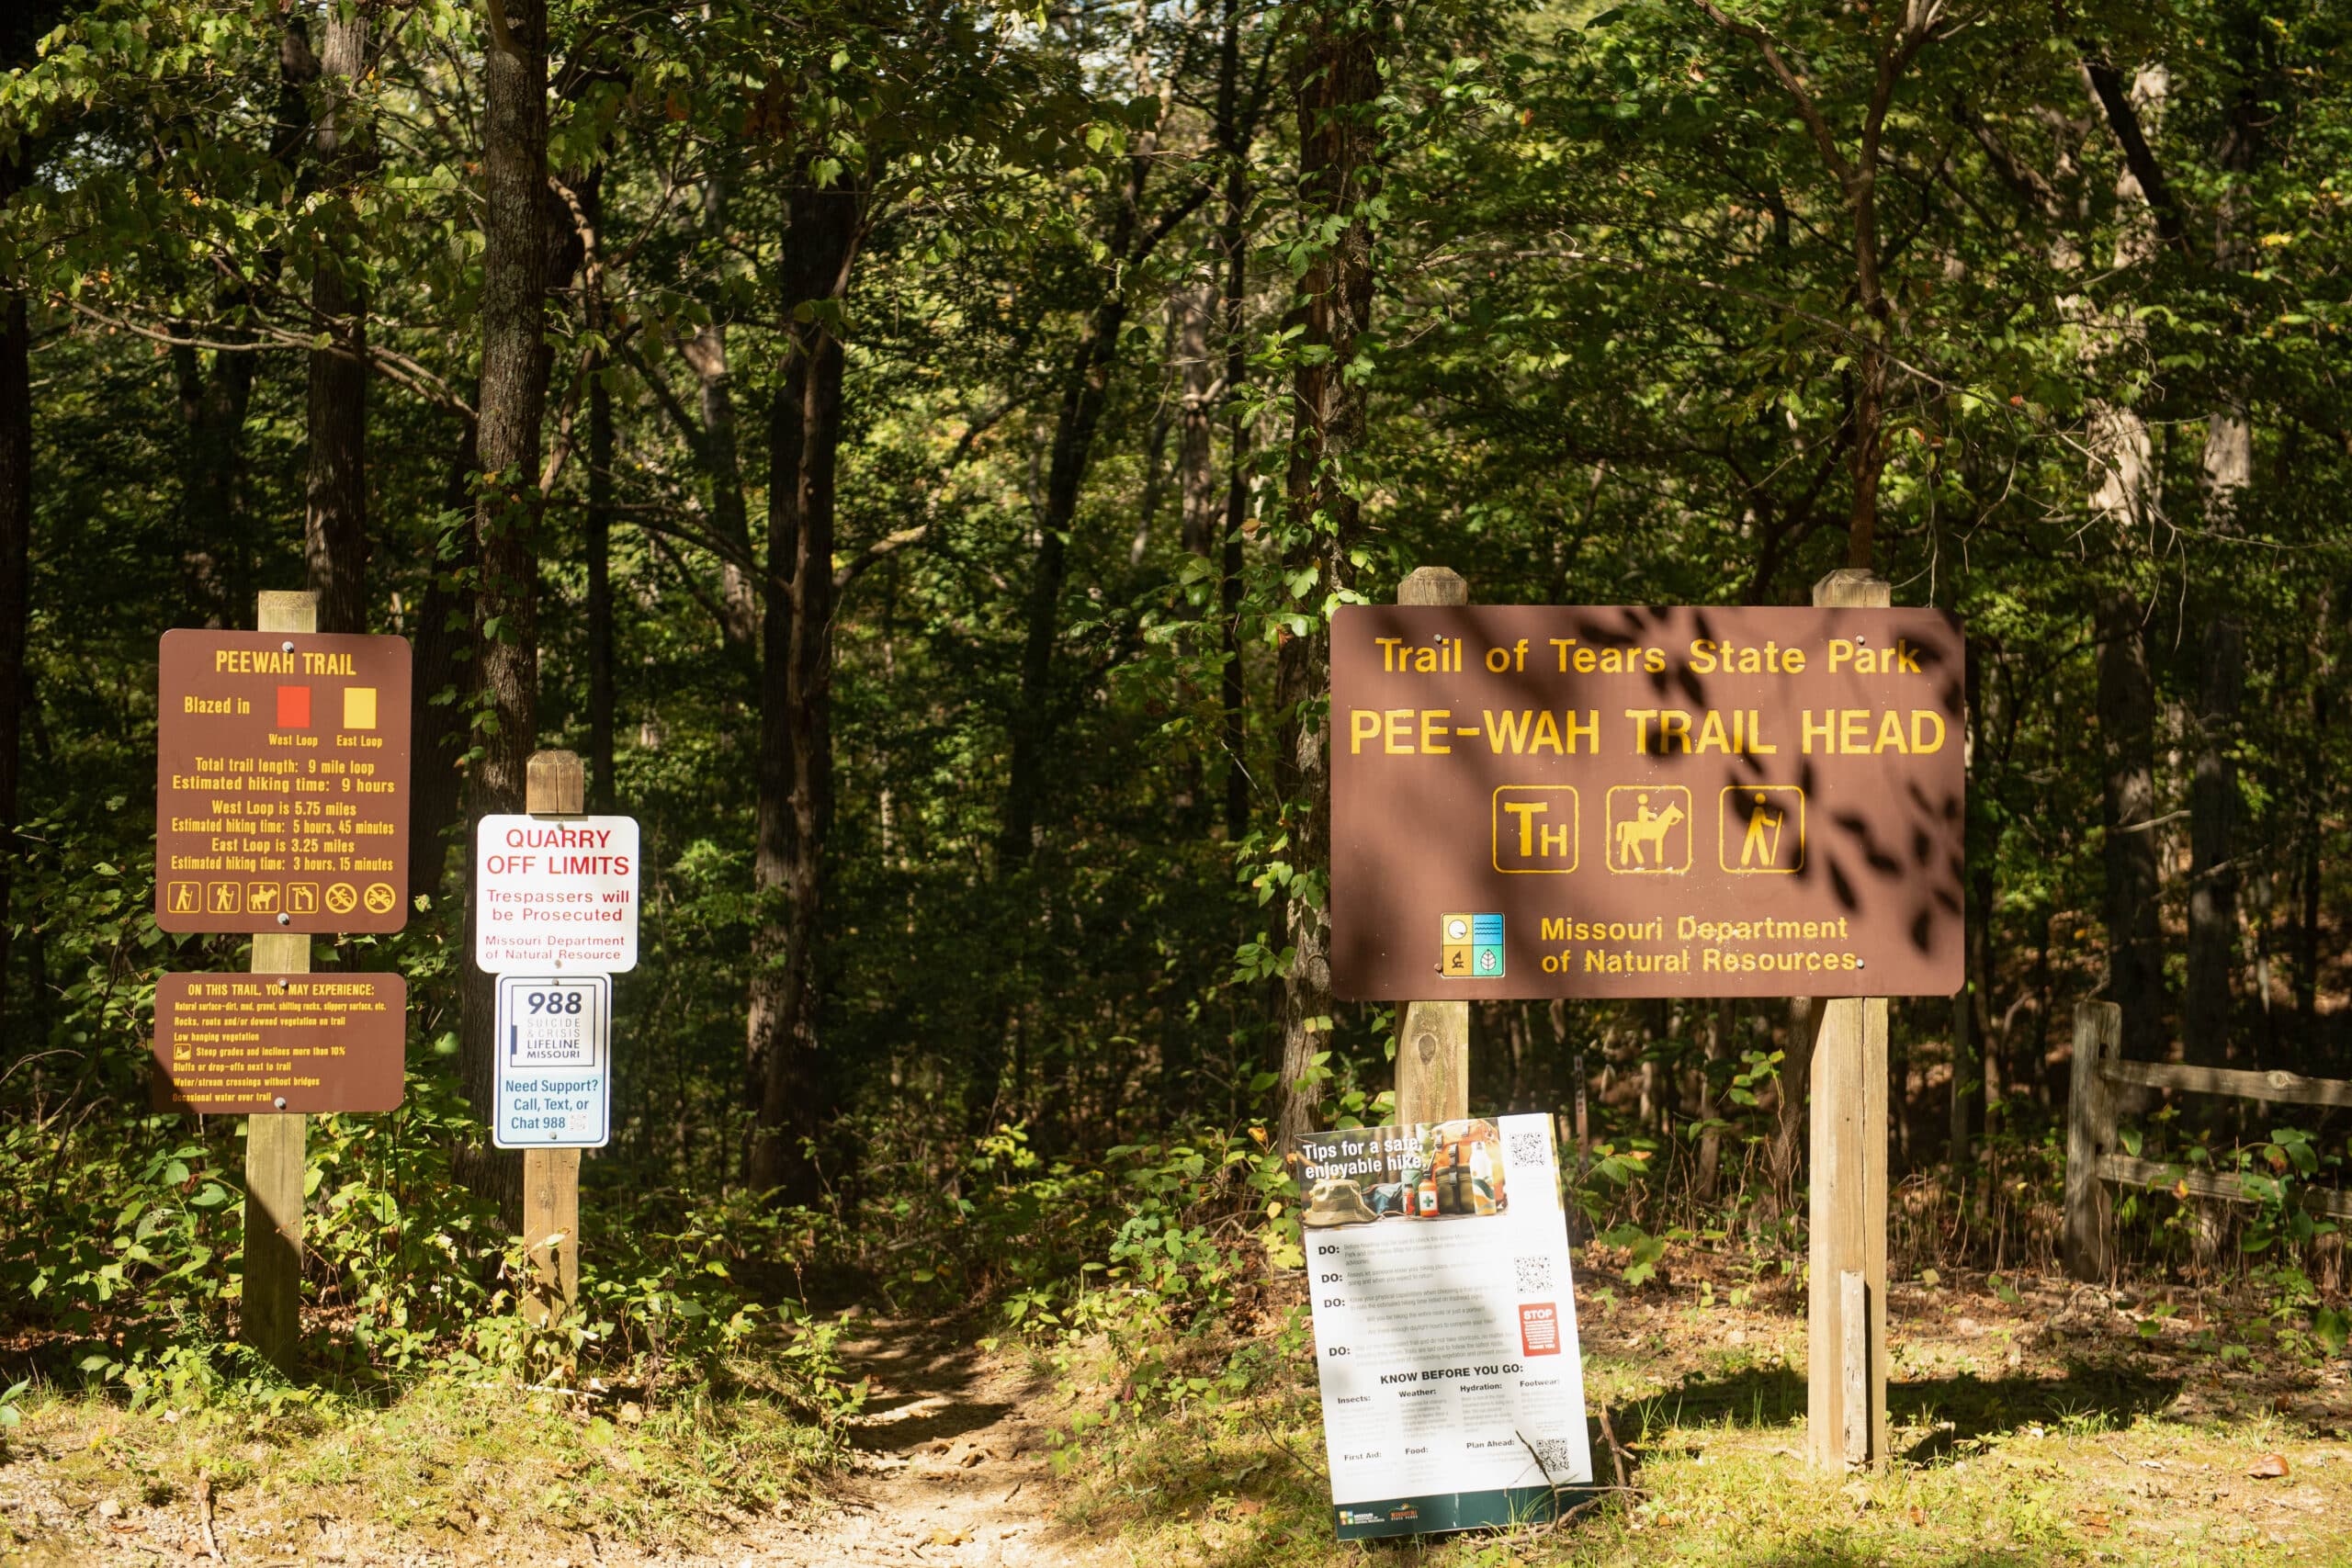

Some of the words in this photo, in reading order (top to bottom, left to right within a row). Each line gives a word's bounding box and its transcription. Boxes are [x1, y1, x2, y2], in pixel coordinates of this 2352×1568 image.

[1375, 638, 1462, 672] Trail
[1487, 639, 1529, 672] of
[1550, 639, 1665, 672] Tears
[1690, 639, 1805, 674] State
[1828, 640, 1921, 674] Park
[216, 650, 294, 673] PEEWAH
[303, 652, 356, 676] TRAIL
[185, 696, 232, 714] Blazed
[237, 698, 250, 714] in
[1351, 710, 1599, 754] PEE-WAH
[1625, 710, 1776, 754] TRAIL
[1803, 710, 1945, 754] HEAD
[269, 735, 292, 745] West
[296, 735, 318, 747] Loop
[337, 735, 356, 746] East
[360, 736, 382, 748] Loop
[196, 757, 224, 772] Total
[230, 759, 254, 772] trail
[258, 760, 297, 774] length:
[309, 760, 316, 773] 9
[322, 760, 345, 773] mile
[350, 761, 375, 776] loop
[173, 775, 243, 790] Estimated
[248, 777, 289, 794] hiking
[296, 778, 329, 792] time:
[342, 779, 350, 792] 9
[356, 779, 394, 793] hours
[212, 801, 242, 814] West
[246, 801, 274, 816] Loop
[279, 802, 289, 815] is
[295, 801, 321, 816] 5.75
[325, 802, 356, 816] miles
[172, 818, 222, 832] Estimated
[226, 819, 256, 835] hiking
[261, 820, 284, 832] time:
[294, 819, 300, 833] 5
[339, 820, 351, 833] 45
[356, 821, 393, 834] minutes
[506, 829, 611, 849] QUARRY
[212, 838, 237, 852] East
[243, 839, 270, 853] Loop
[276, 839, 286, 852] is
[291, 839, 319, 852] 3.25
[323, 839, 354, 852] miles
[171, 855, 221, 869] Estimated
[226, 857, 255, 872] hiking
[260, 857, 285, 870] time:
[294, 857, 300, 870] 3
[340, 857, 351, 871] 15
[355, 860, 393, 871] minutes
[487, 856, 536, 874] OFF
[549, 857, 628, 875] LIMITS
[487, 889, 593, 904] Trespassers
[603, 890, 628, 902] will
[492, 908, 513, 920] be
[524, 908, 622, 921] Prosecuted
[1542, 918, 1662, 941] Missouri
[1677, 917, 1848, 944] Department
[486, 936, 540, 945] Missouri
[548, 936, 624, 947] Department
[486, 950, 498, 959] of
[506, 950, 551, 959] Natural
[559, 950, 621, 959] Resource
[1542, 951, 1570, 973] of
[1586, 951, 1688, 972] Natural
[1702, 949, 1856, 971] Resources
[188, 985, 202, 995] ON
[206, 985, 228, 995] THIS
[288, 985, 309, 995] MAY
[312, 984, 375, 996] EXPERIENCE:
[528, 992, 582, 1014] 988
[202, 1018, 220, 1026] roots
[224, 1018, 247, 1026] and/or
[280, 1018, 318, 1026] vegetation
[527, 1018, 581, 1028] SUICIDE
[174, 1033, 188, 1042] Low
[191, 1033, 220, 1042] hanging
[222, 1033, 259, 1042] vegetation
[527, 1029, 534, 1038] &
[537, 1029, 581, 1038] CRISIS
[527, 1040, 580, 1049] LIFELINE
[197, 1047, 217, 1056] Steep
[220, 1049, 244, 1057] grades
[263, 1047, 290, 1055] inclines
[174, 1063, 195, 1071] Bluffs
[208, 1062, 244, 1072] drop-offs
[174, 1078, 223, 1087] Water/stream
[226, 1078, 262, 1087] crossings
[265, 1077, 291, 1086] without
[294, 1077, 320, 1087] bridges
[506, 1080, 537, 1091] Need
[542, 1079, 598, 1094] Support?
[256, 1092, 271, 1101] trail
[514, 1099, 540, 1111] Call,
[544, 1099, 572, 1111] Text,
[576, 1100, 589, 1110] or
[512, 1117, 539, 1129] Chat
[544, 1117, 565, 1128] 988
[1303, 1143, 1338, 1160] Tips
[1341, 1141, 1363, 1156] for
[1369, 1143, 1381, 1155] a
[1305, 1156, 1382, 1179] enjoyable
[1318, 1246, 1340, 1255] DO:
[1322, 1273, 1342, 1282] DO:
[1325, 1299, 1345, 1307] DO:
[1523, 1309, 1553, 1319] STOP
[1329, 1347, 1350, 1356] DO:
[1381, 1372, 1418, 1384] KNOW
[1421, 1368, 1470, 1380] BEFORE
[1474, 1366, 1499, 1377] YOU
[1502, 1364, 1522, 1373] GO:
[1399, 1389, 1436, 1397] Weather:
[1460, 1383, 1501, 1393] Hydration:
